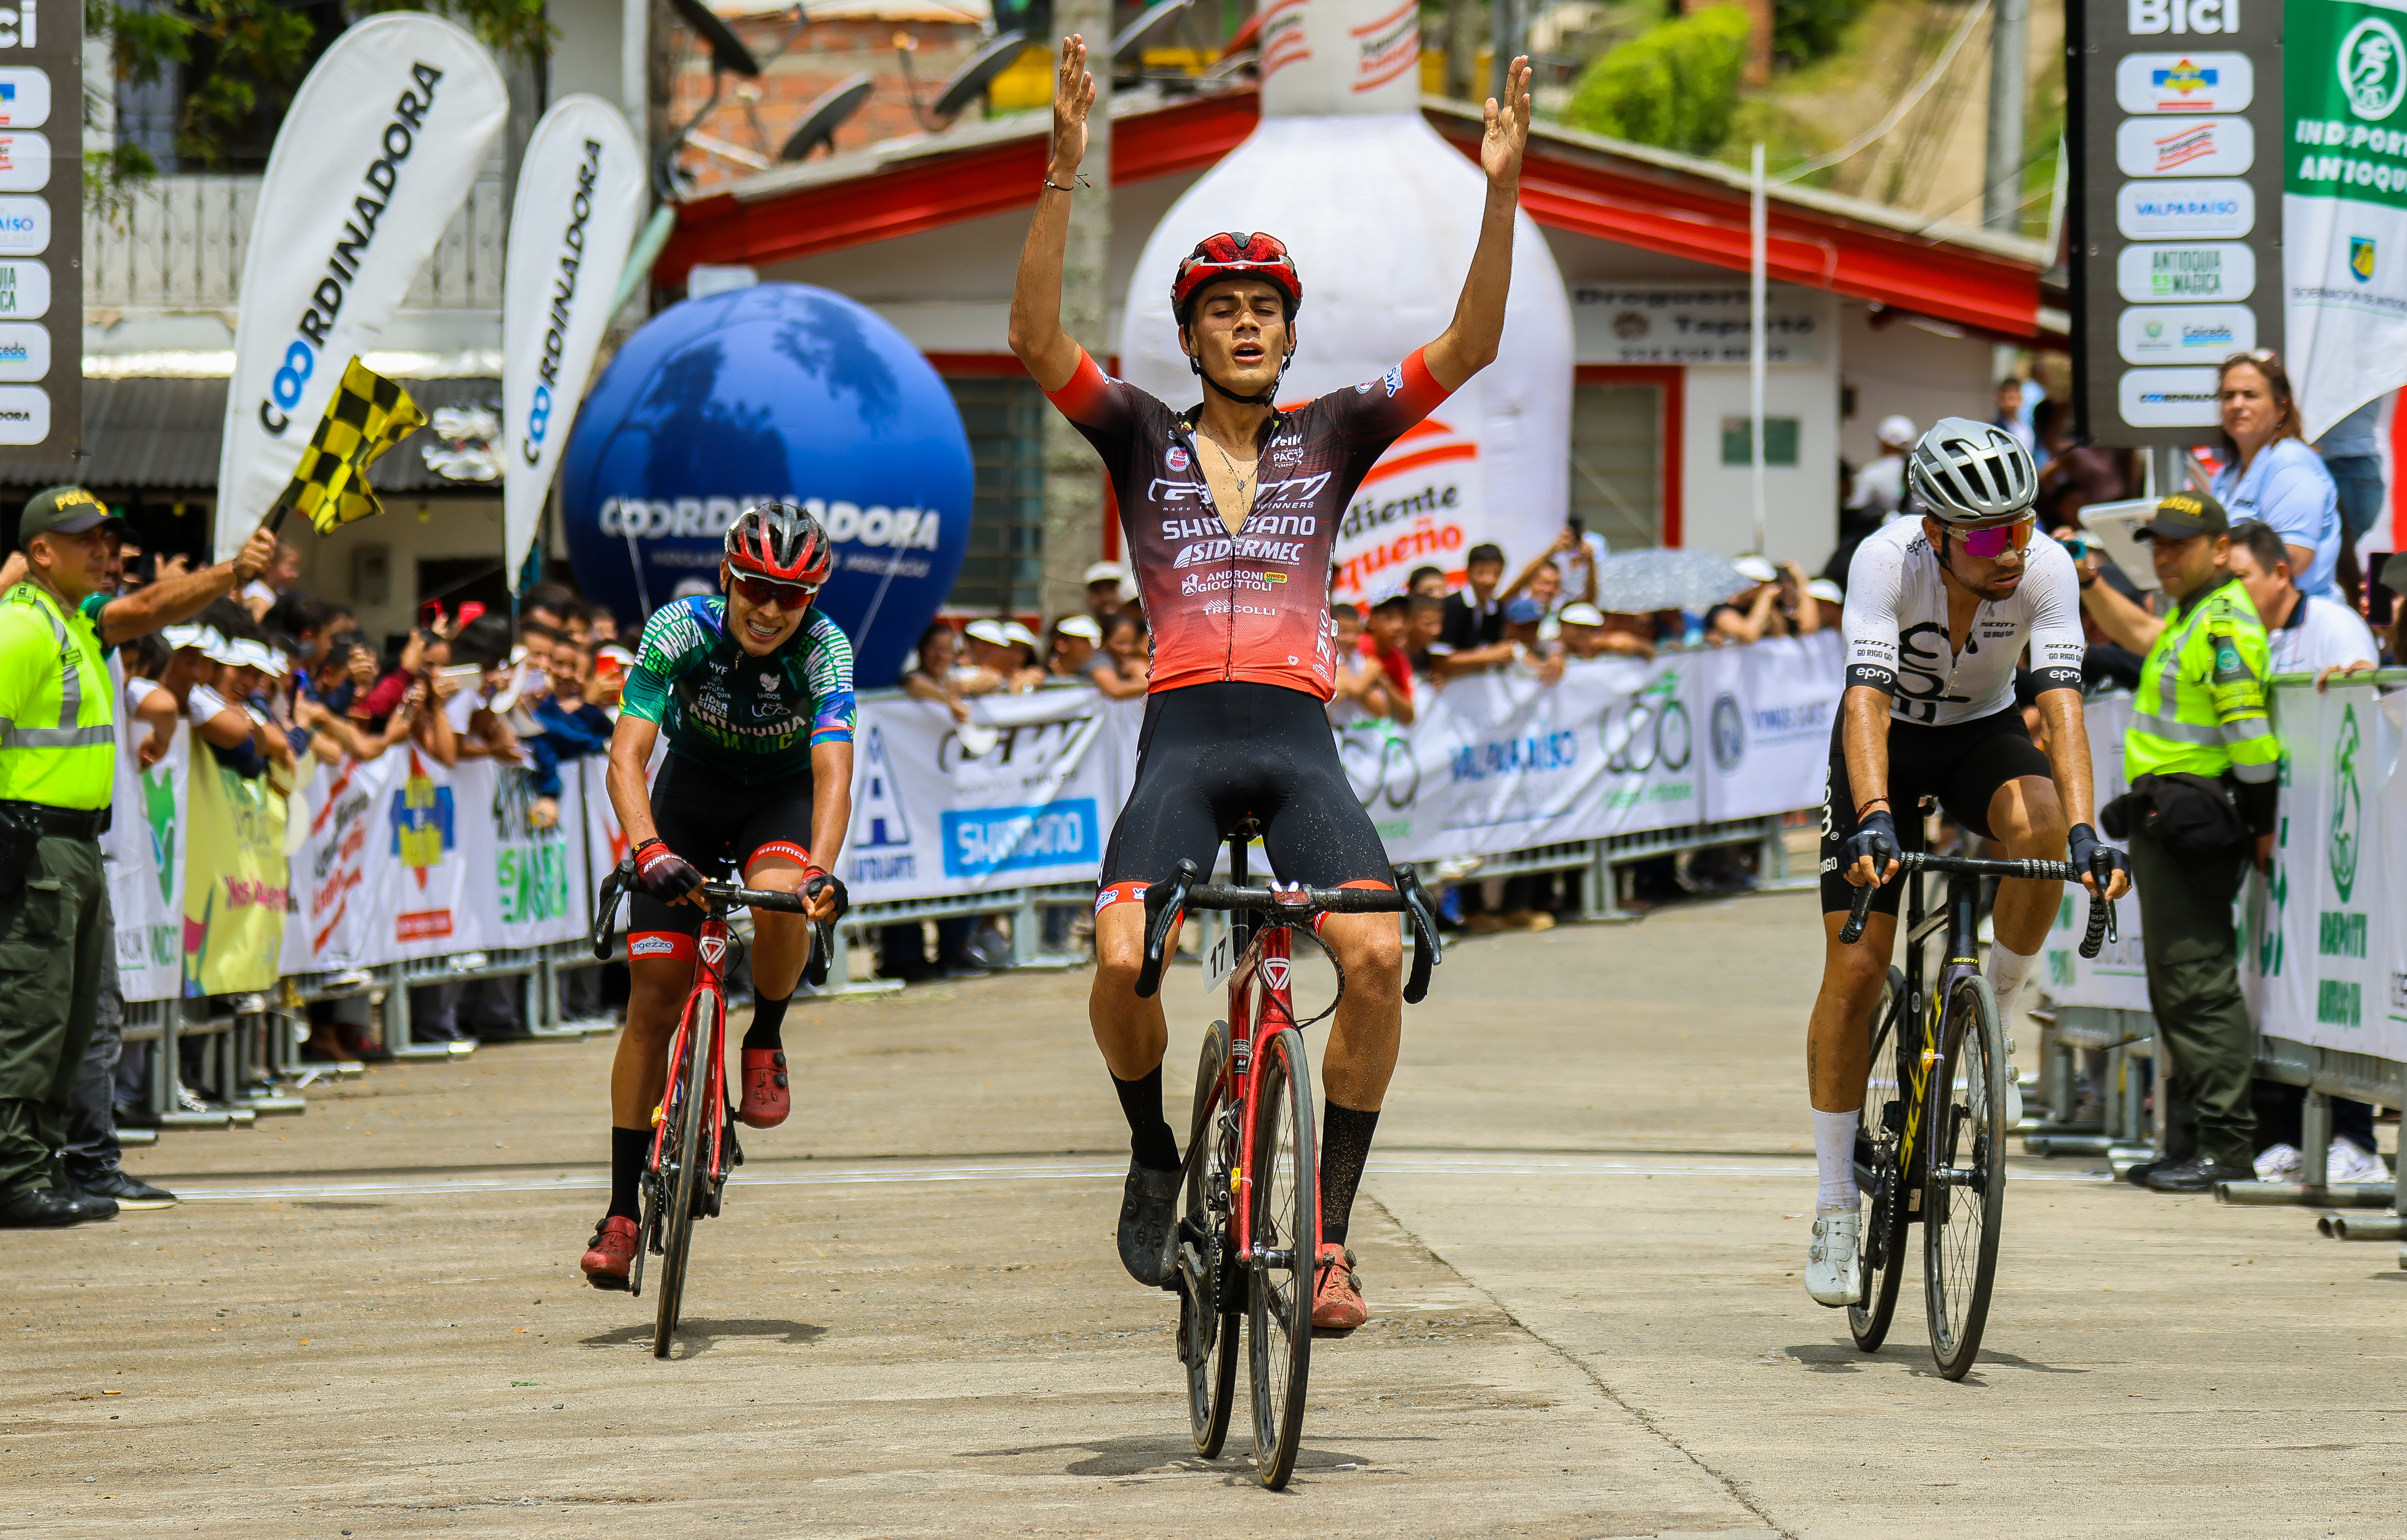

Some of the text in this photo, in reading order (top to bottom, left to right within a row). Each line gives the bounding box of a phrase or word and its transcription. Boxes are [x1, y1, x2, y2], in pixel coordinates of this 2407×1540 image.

[2127, 0, 2239, 35] Bici
[257, 59, 445, 437] COORDINADORA
[522, 137, 602, 468] COORDINADORA
[1257, 502, 1314, 510] WINNERS
[1191, 539, 1304, 561] SIDERMEC
[1206, 570, 1264, 582] ANDRONI
[1198, 579, 1272, 593] GIOCATTOLI
[1852, 639, 1898, 650] SCOTT
[1867, 649, 1883, 659] RIGO
[1855, 667, 1892, 684] epm
[2049, 669, 2081, 683] epm
[697, 700, 728, 719] SUB23
[699, 692, 728, 712] LÍDER
[631, 941, 673, 950] vigezzo
[1210, 935, 1227, 980] 17
